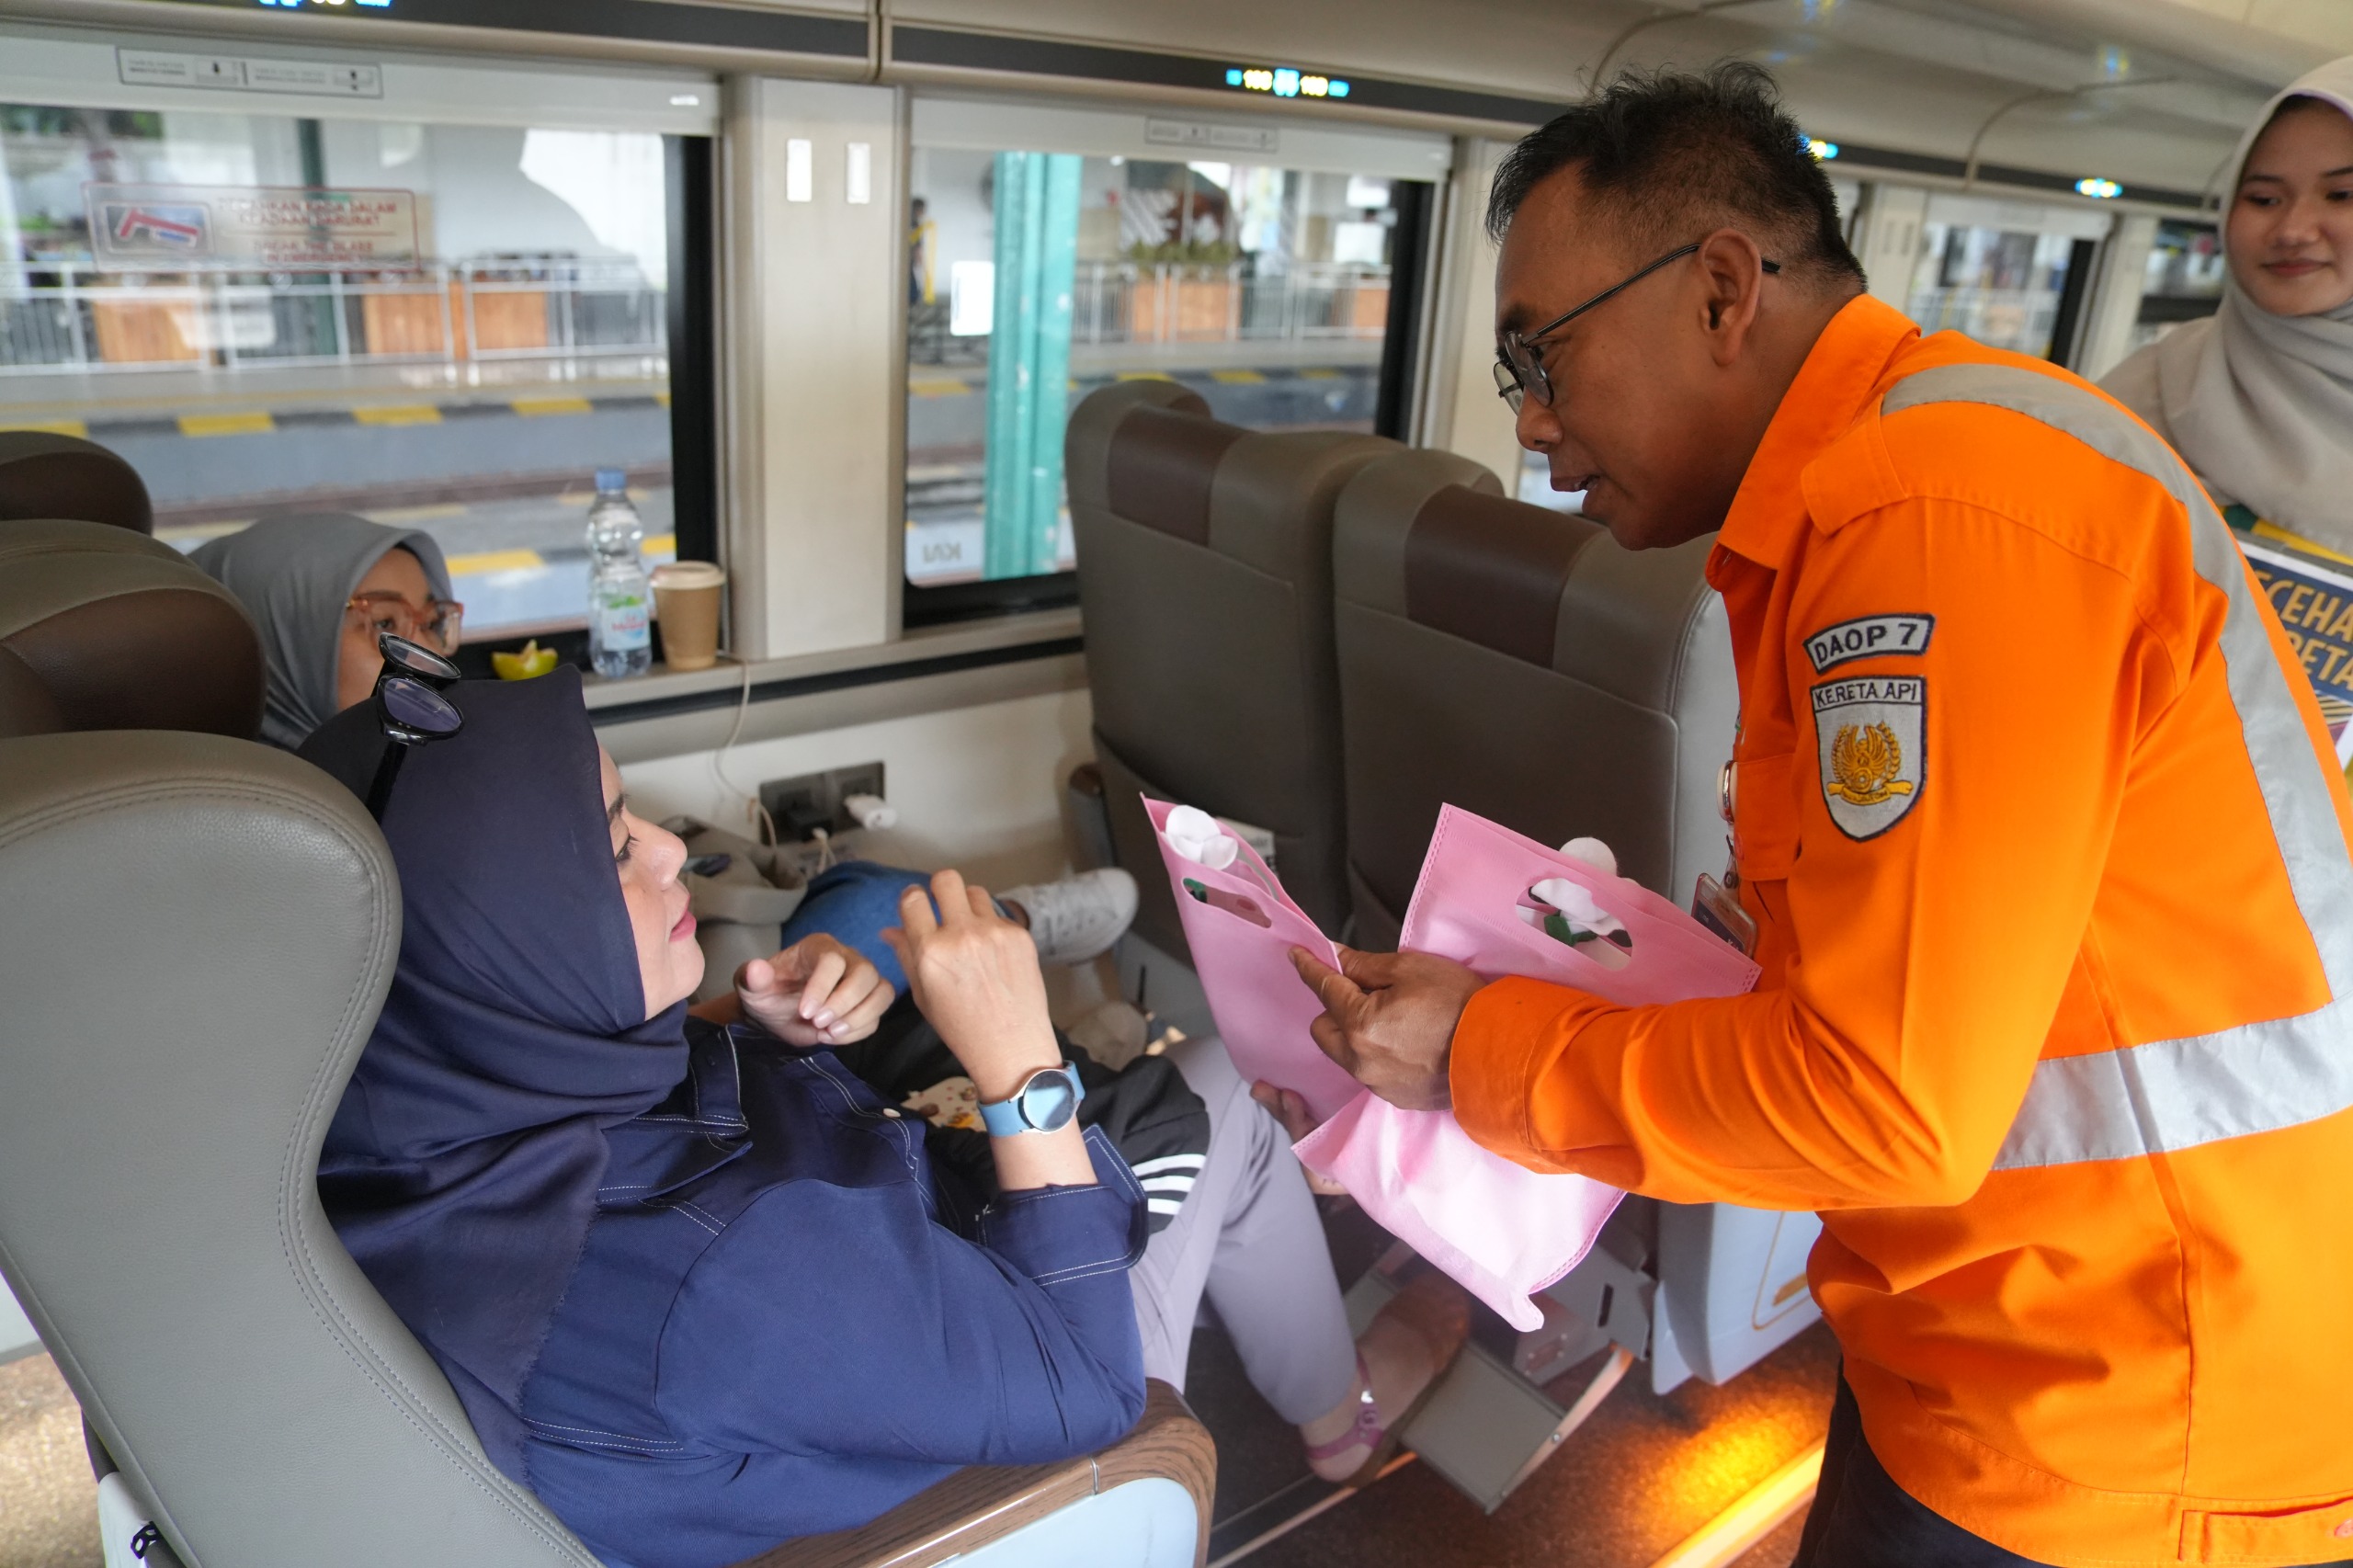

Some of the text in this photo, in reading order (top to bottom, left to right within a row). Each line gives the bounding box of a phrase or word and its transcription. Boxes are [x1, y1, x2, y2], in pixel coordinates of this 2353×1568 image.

[2255, 569, 2353, 643] CEHA
[1813, 622, 1919, 665] DAOP 7
[1814, 683, 1919, 708] KERETA API
